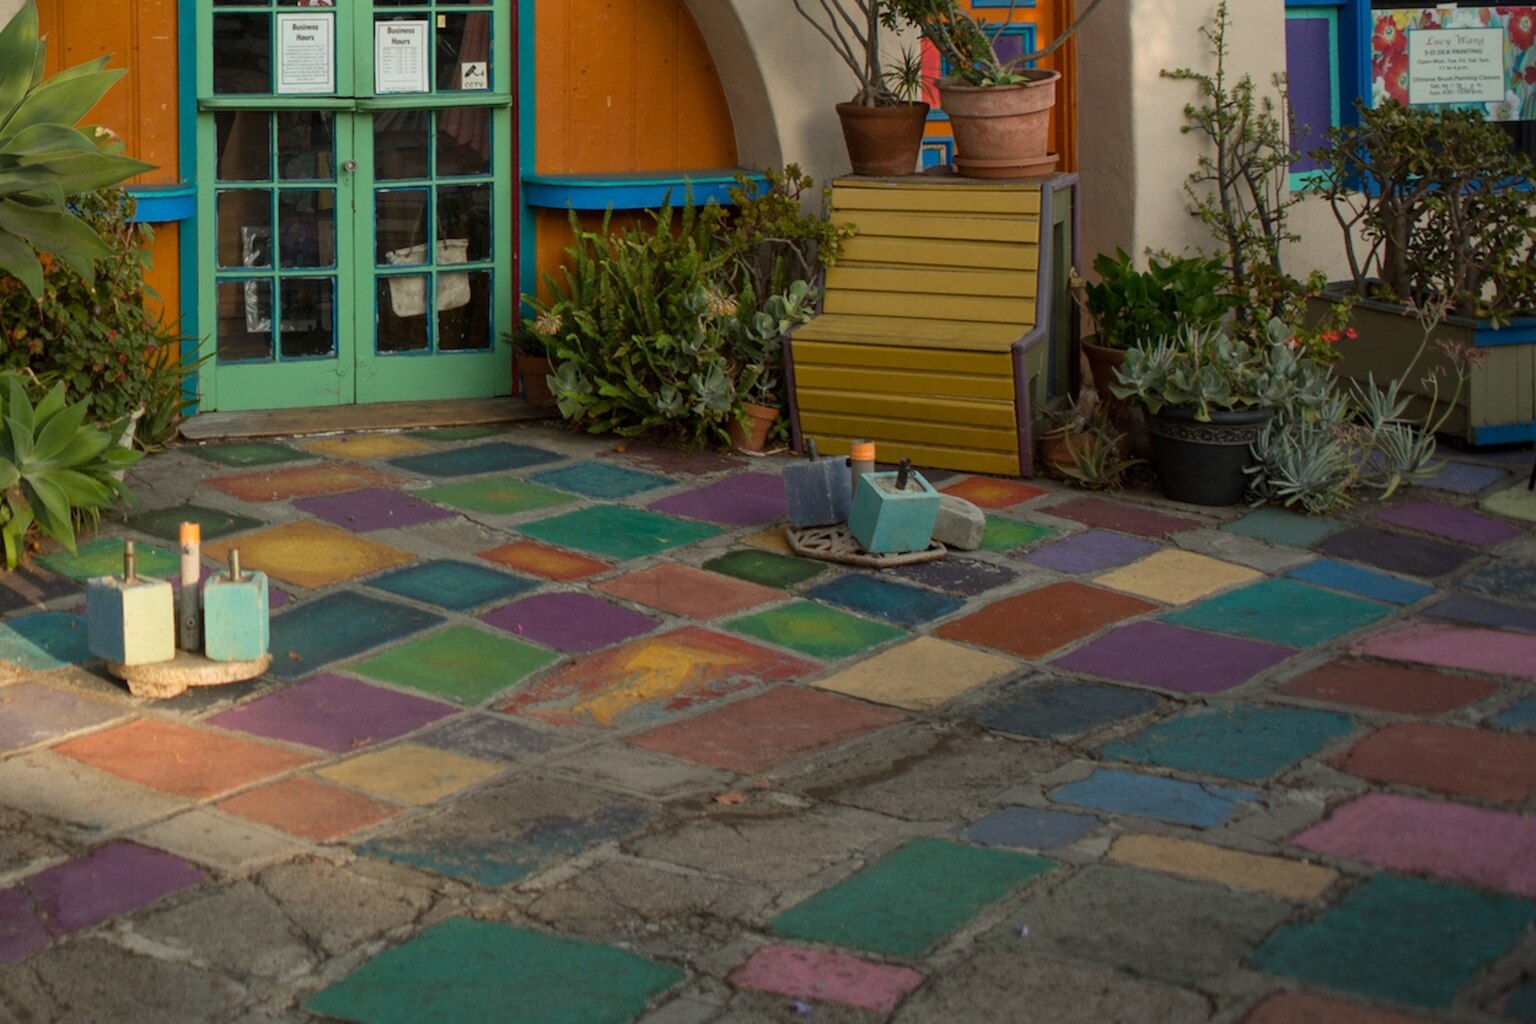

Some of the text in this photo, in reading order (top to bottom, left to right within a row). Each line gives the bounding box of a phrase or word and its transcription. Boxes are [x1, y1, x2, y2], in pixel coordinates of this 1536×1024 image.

[292, 23, 319, 31] Business
[391, 37, 410, 45] Hours
[1425, 34, 1485, 47] Lucy Wang
